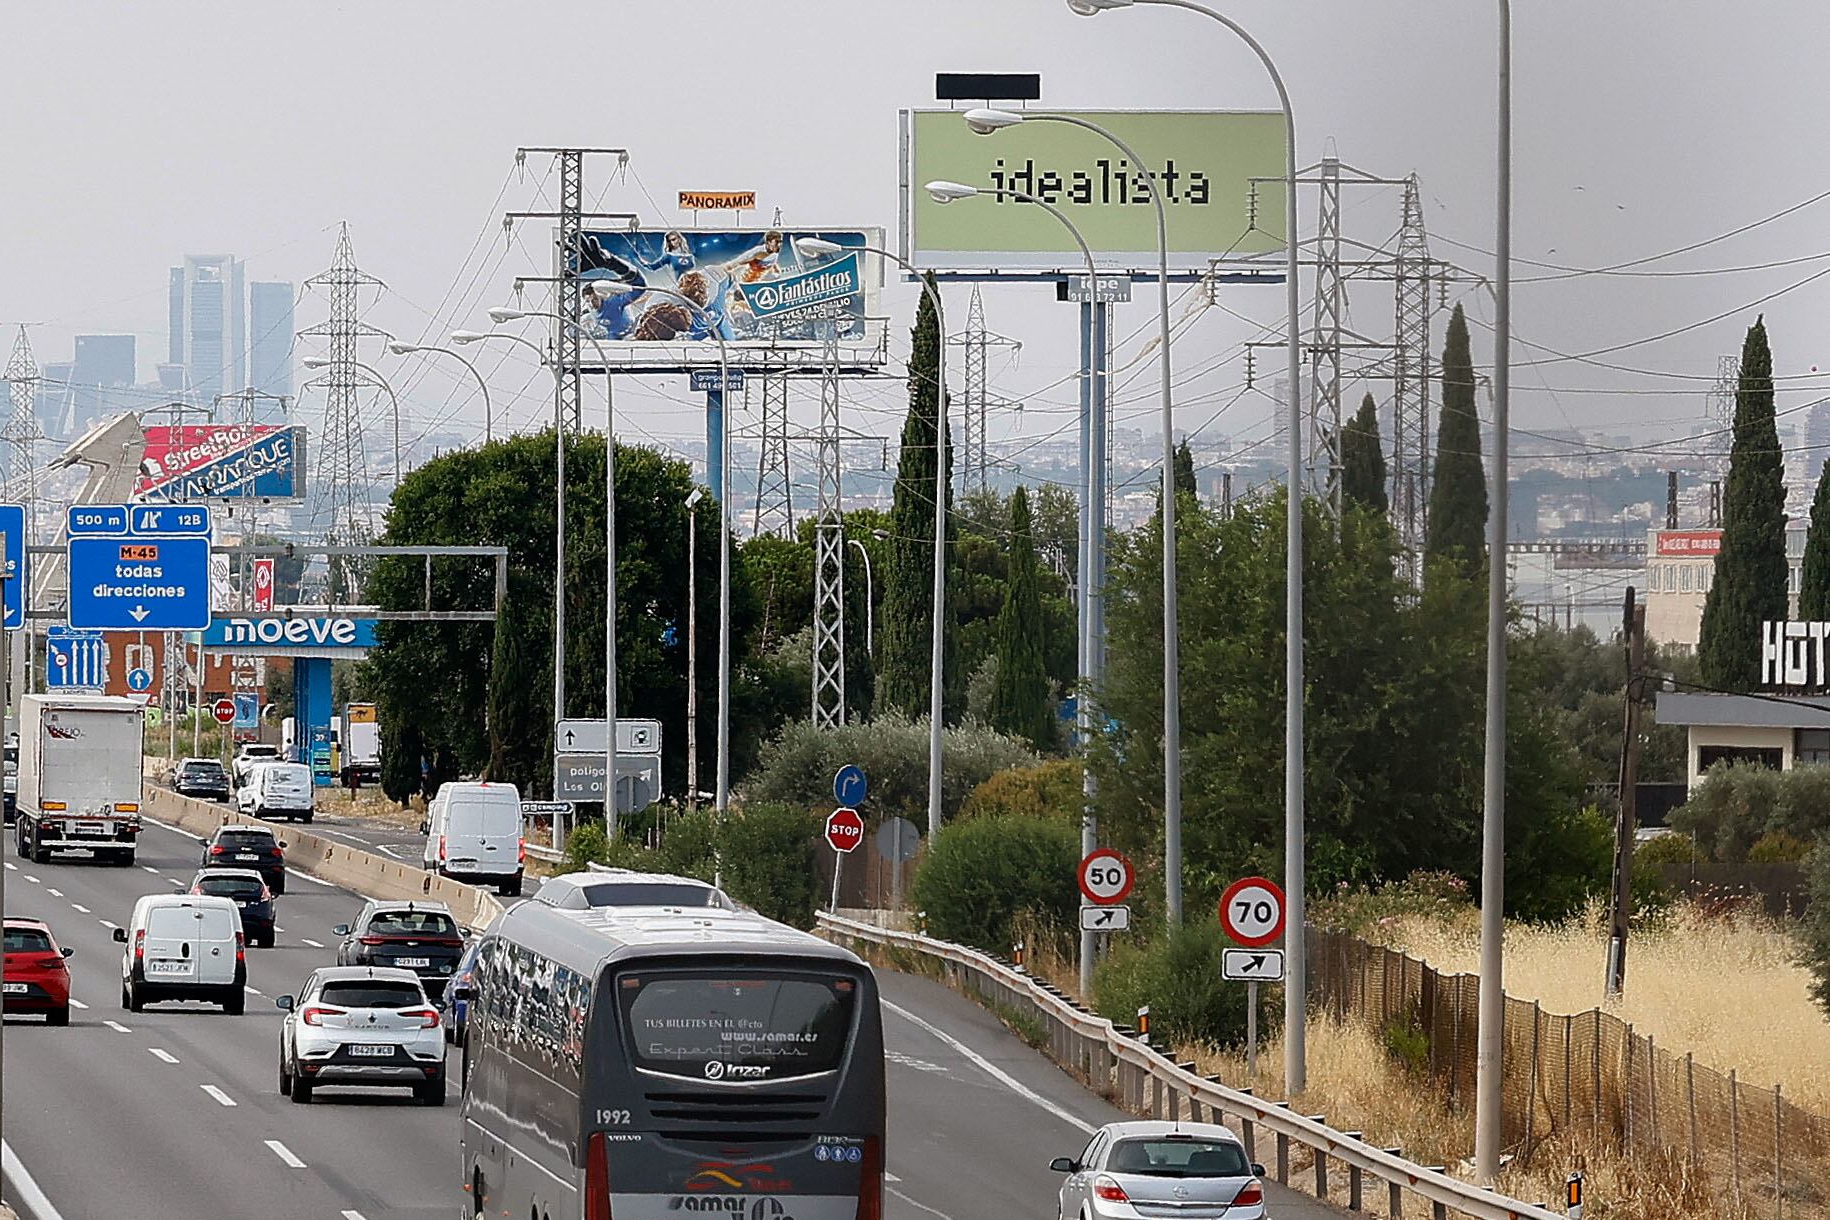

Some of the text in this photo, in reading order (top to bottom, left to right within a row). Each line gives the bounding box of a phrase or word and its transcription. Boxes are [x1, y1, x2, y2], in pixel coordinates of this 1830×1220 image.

[991, 159, 1209, 204] idealista
[679, 191, 756, 209] PANORAMIX
[778, 271, 852, 305] Fantásticos
[1085, 292, 1101, 301] 63
[76, 515, 120, 526] 500 m
[178, 515, 202, 526] 12B
[120, 547, 157, 559] M-45
[115, 564, 163, 578] todas
[93, 583, 186, 598] direcciones
[224, 618, 356, 644] moeve
[1762, 620, 1830, 686] HOT
[570, 766, 619, 777] poligo
[564, 782, 584, 791] Los
[830, 824, 859, 836] STOP
[1090, 869, 1122, 886] 50
[1235, 902, 1273, 924] 70
[644, 1019, 664, 1029] TUS
[666, 1018, 707, 1029] BILLETES
[709, 1019, 721, 1029] EN
[721, 1032, 819, 1043] www.samar.es
[596, 1109, 631, 1124] 1992
[608, 1134, 642, 1142] VOLVO
